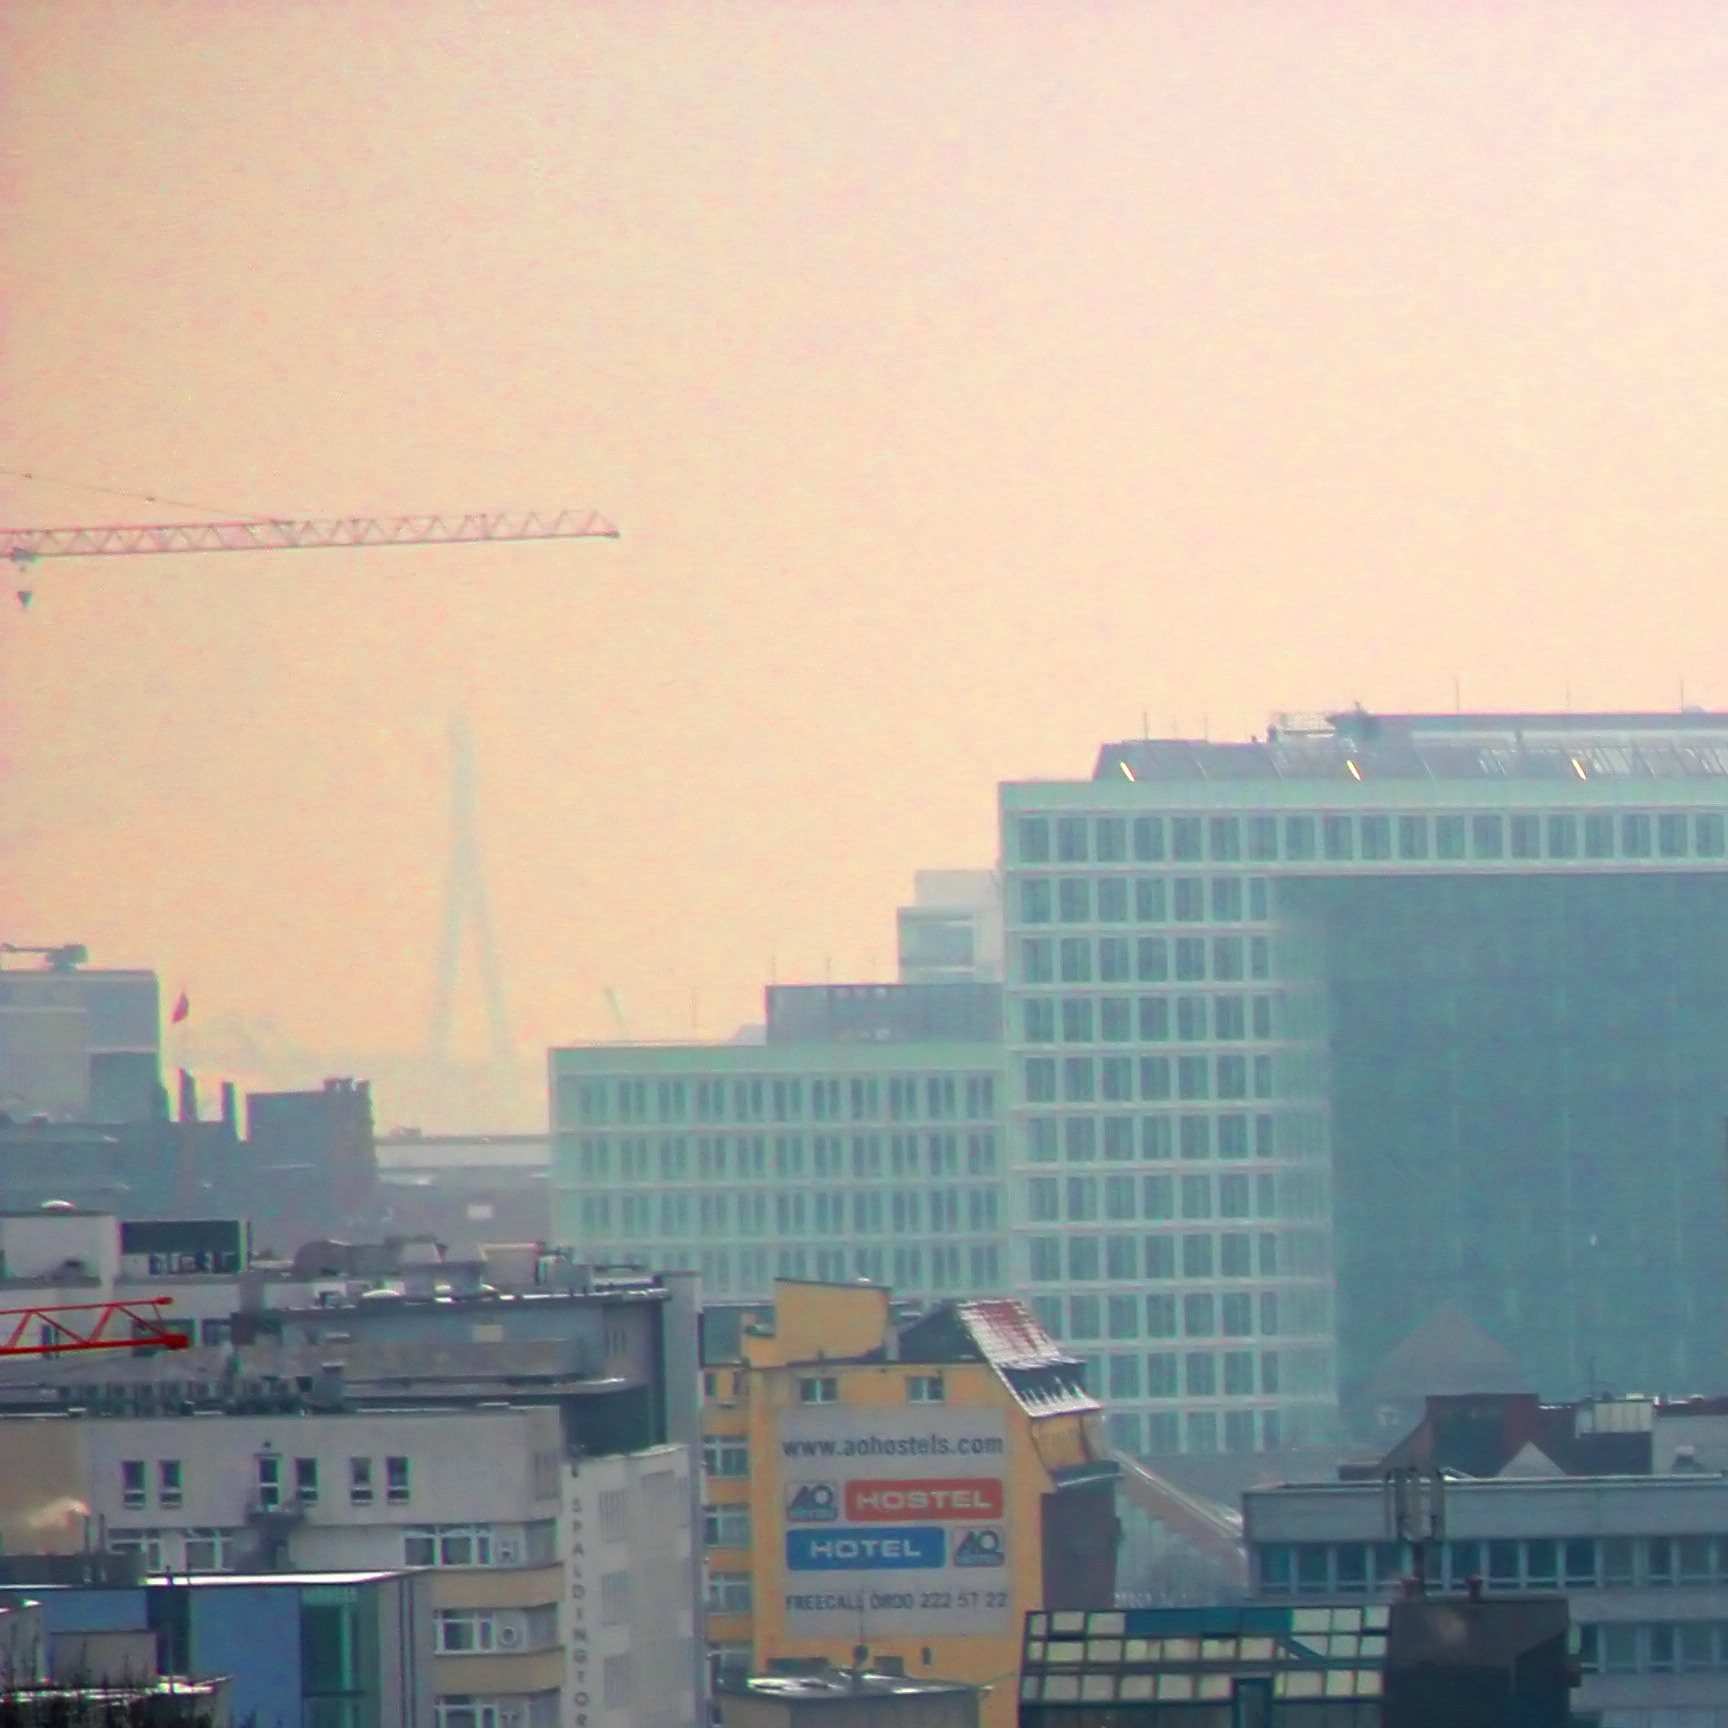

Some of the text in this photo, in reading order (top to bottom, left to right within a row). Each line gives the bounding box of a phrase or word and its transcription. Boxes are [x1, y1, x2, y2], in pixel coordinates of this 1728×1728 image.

[783, 1434, 1004, 1457] www.aohostels.com
[855, 1489, 994, 1511] HOSTEL
[810, 1539, 922, 1559] HOTEL
[571, 1497, 589, 1728] SPALDINGTOR
[786, 1593, 864, 1612] FREECALL
[919, 1592, 952, 1609] 222
[957, 1592, 979, 1608] 57
[984, 1591, 1008, 1608] 22
